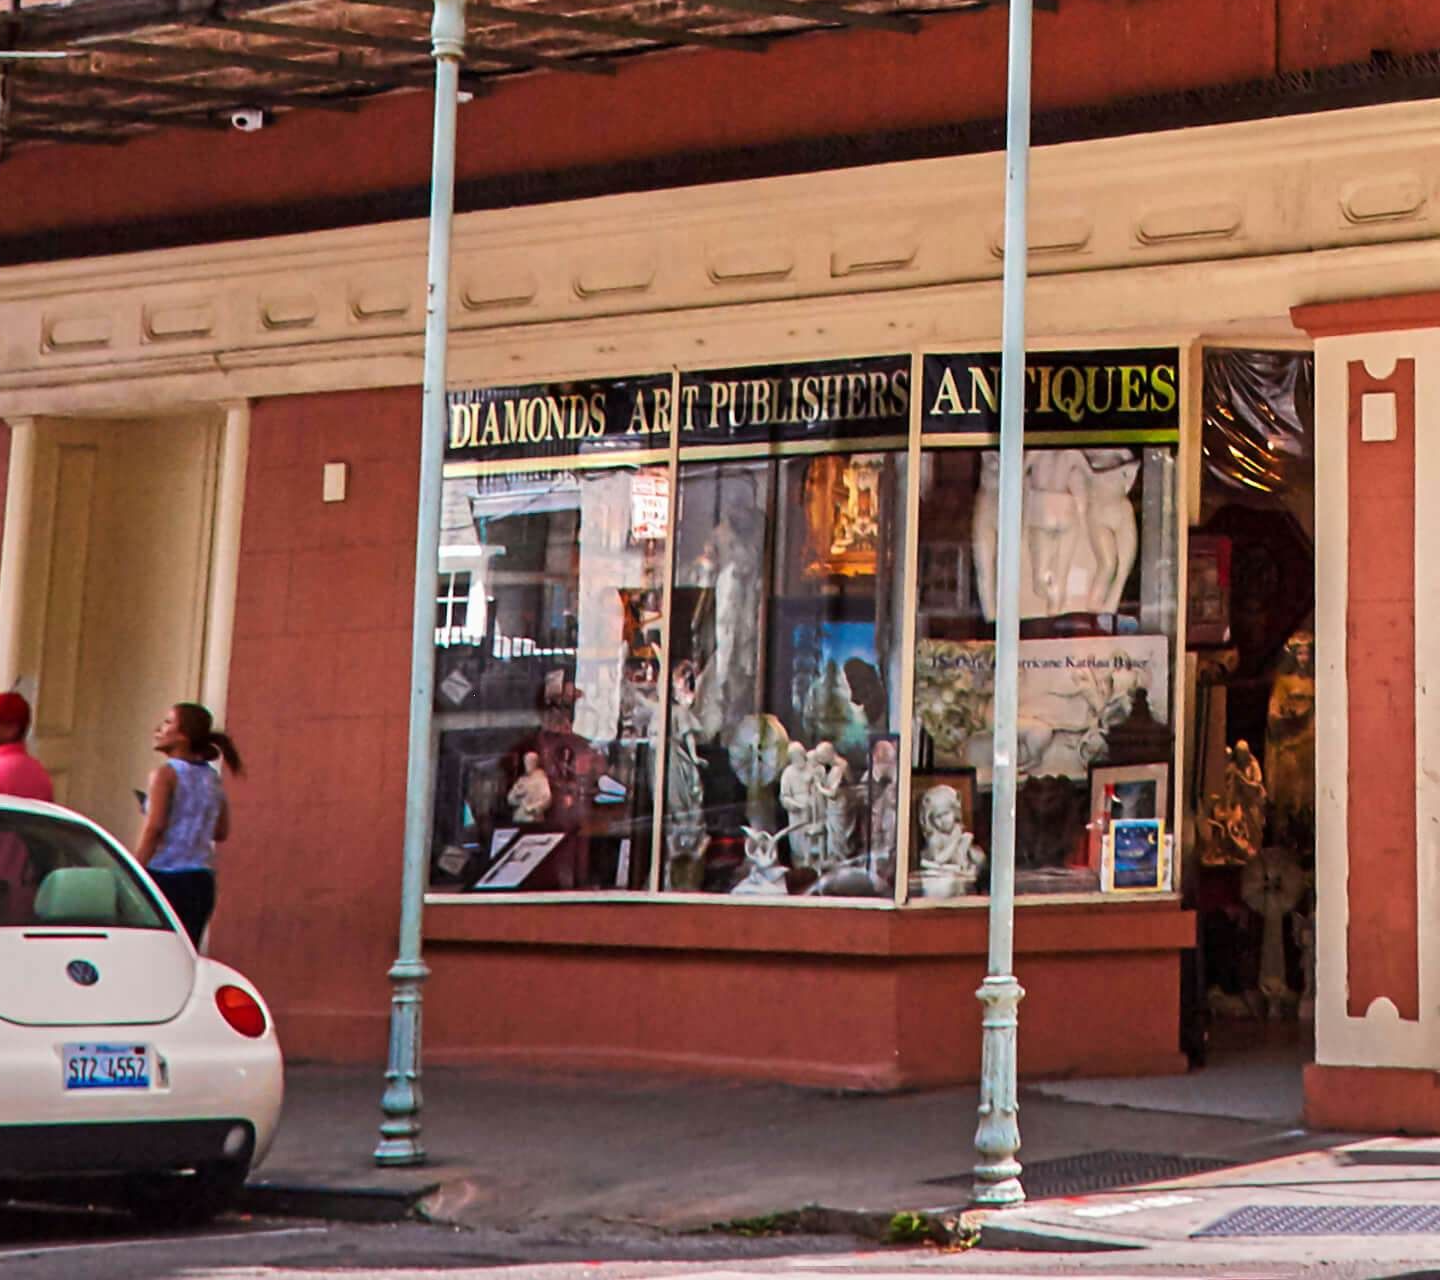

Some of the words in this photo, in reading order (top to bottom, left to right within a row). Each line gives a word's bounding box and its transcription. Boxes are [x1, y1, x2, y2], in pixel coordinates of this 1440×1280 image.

[449, 393, 607, 450] DIAMONDS
[626, 384, 700, 437] ART
[709, 369, 911, 430] PUBLISHERS
